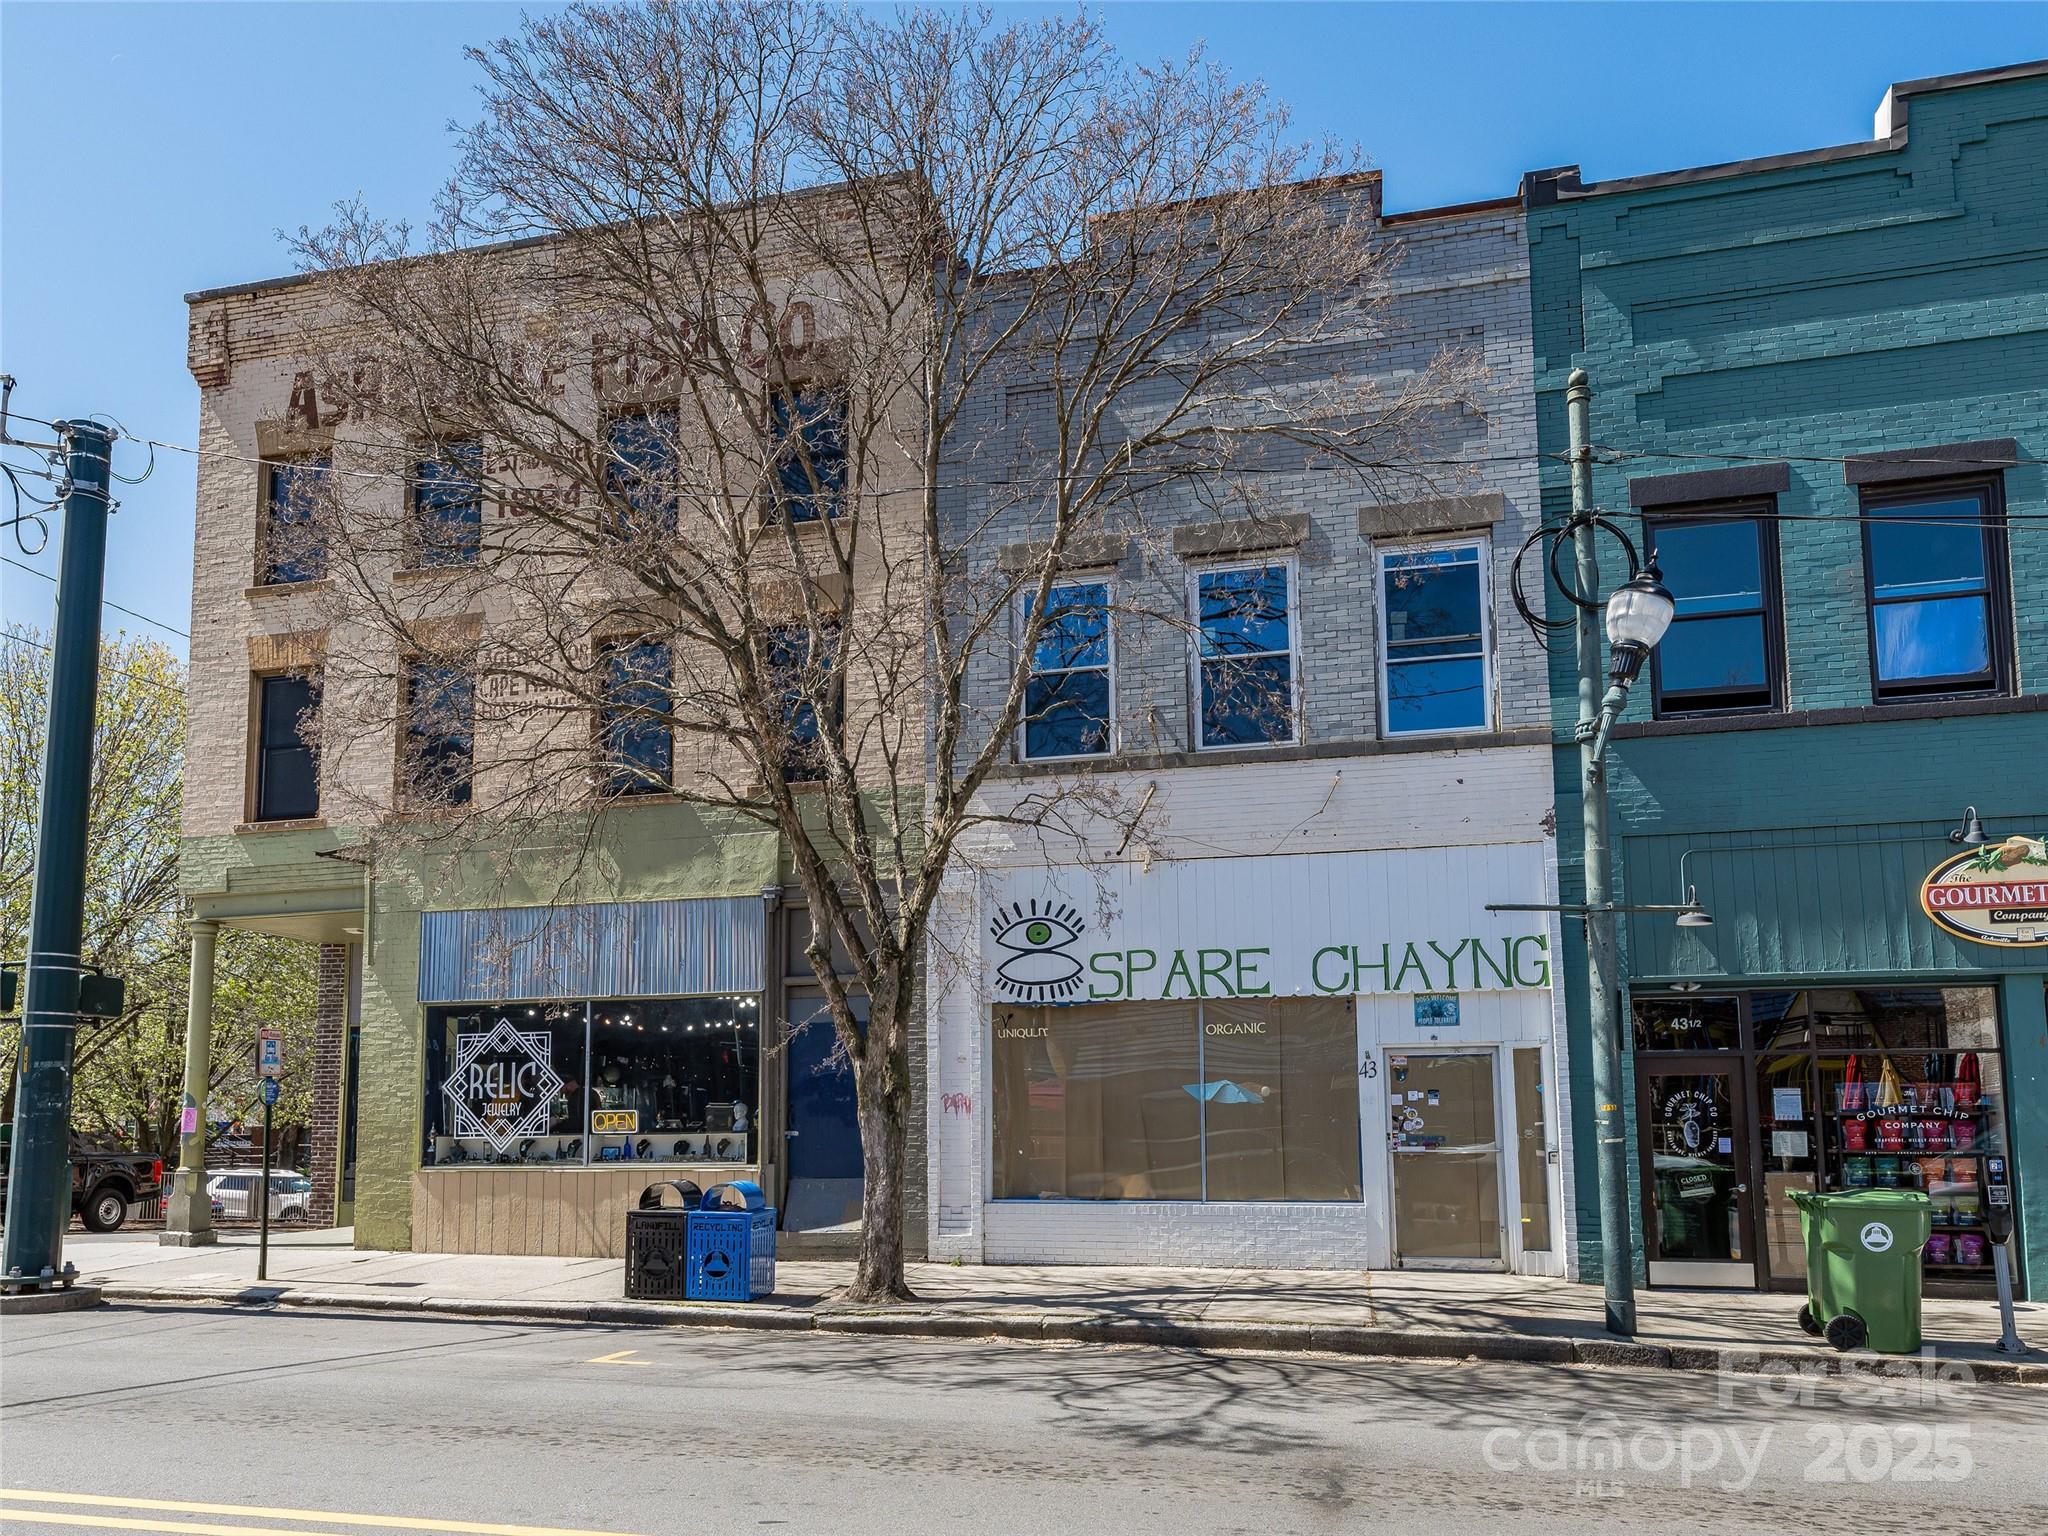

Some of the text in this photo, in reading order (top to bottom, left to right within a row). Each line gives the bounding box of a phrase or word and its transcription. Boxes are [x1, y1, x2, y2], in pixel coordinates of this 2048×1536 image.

[1950, 873, 1982, 882] The
[1929, 884, 2048, 906] GOURMET
[1088, 934, 1550, 998] SPARE CHAYNG
[1205, 1022, 1266, 1035] ORGANIC
[1359, 1061, 1377, 1078] 43
[469, 1062, 536, 1099] RELIC
[481, 1102, 522, 1116] JEWELRY
[1664, 1090, 1718, 1118] GOURMET CHIP CO
[1856, 1105, 1970, 1121] GOURMET CHIP
[594, 1113, 636, 1130] OPEN
[1680, 1174, 1707, 1184] CLOSED
[635, 1221, 680, 1231] LANDFILL
[693, 1223, 743, 1232] RECYCLING
